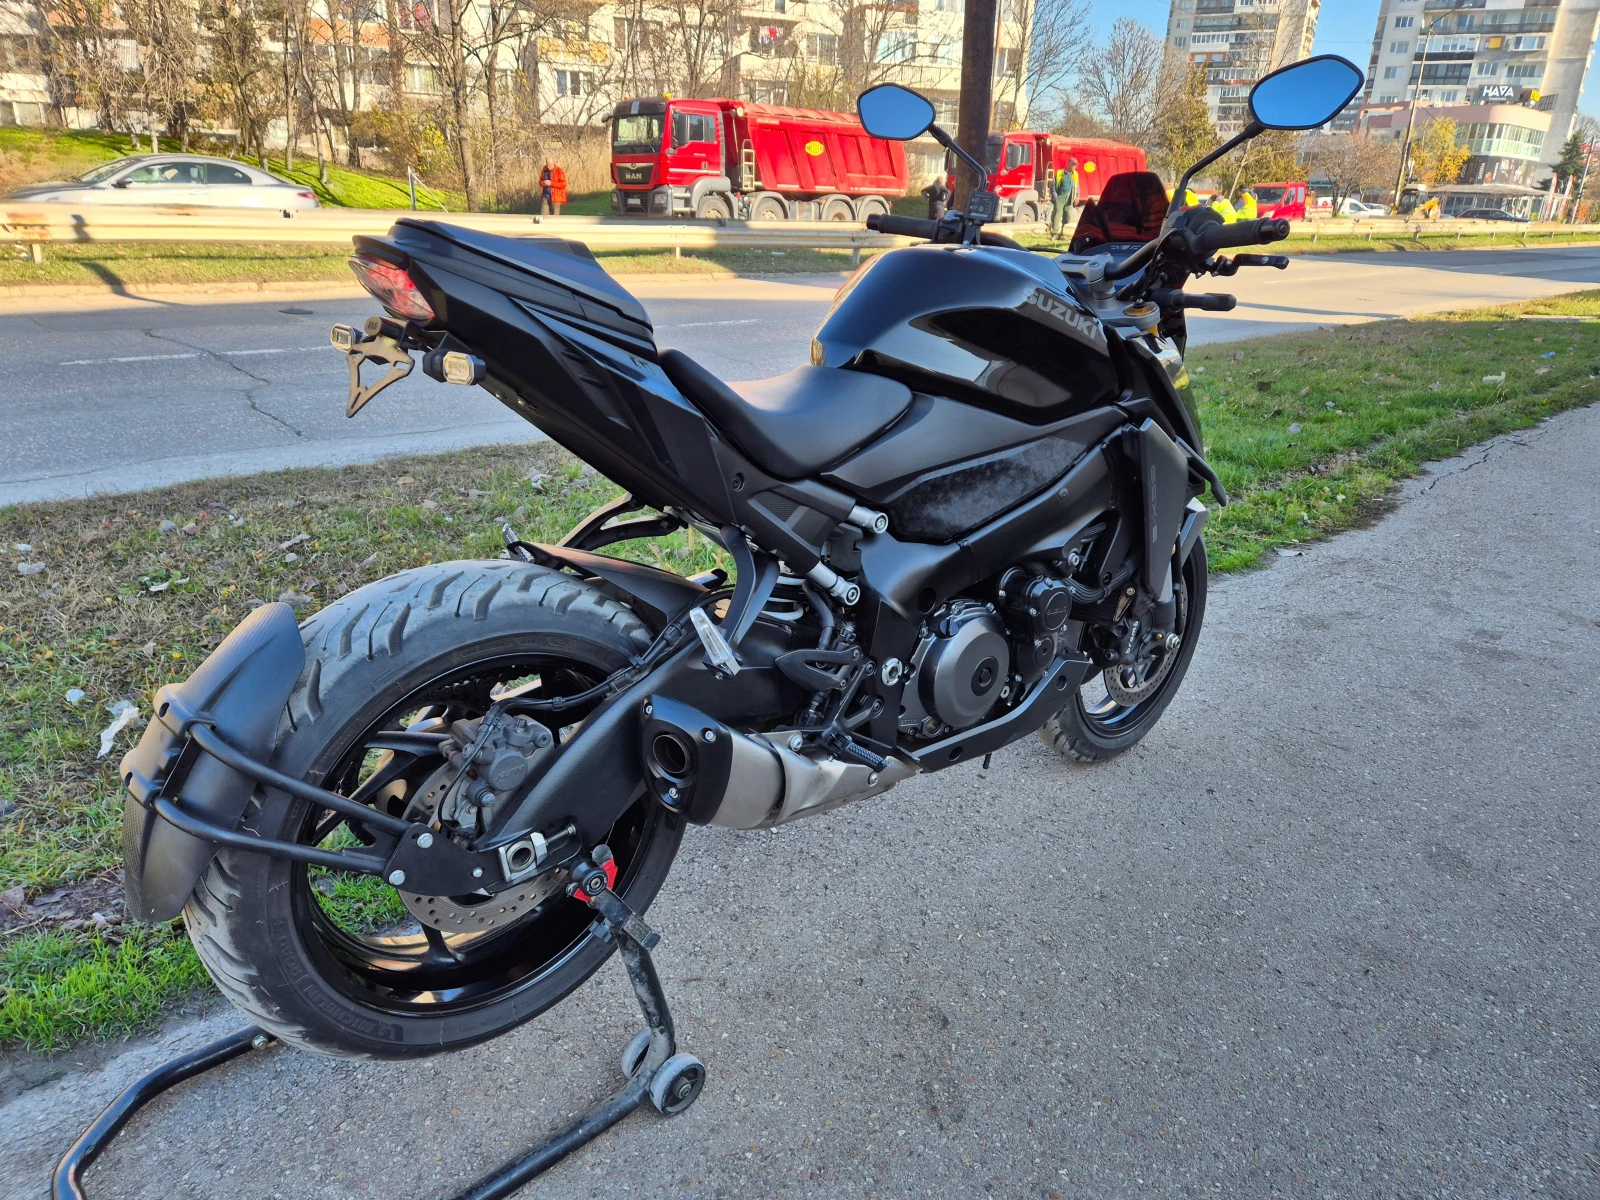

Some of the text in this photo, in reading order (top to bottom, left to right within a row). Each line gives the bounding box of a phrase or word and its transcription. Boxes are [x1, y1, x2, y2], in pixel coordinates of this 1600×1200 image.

[1482, 85, 1514, 97] HAVA
[625, 172, 642, 180] MAN
[1022, 287, 1098, 340] SUZUKI
[1125, 620, 1139, 654] bremb
[277, 935, 303, 977] ROAD
[303, 984, 376, 1032] MICHELIN
